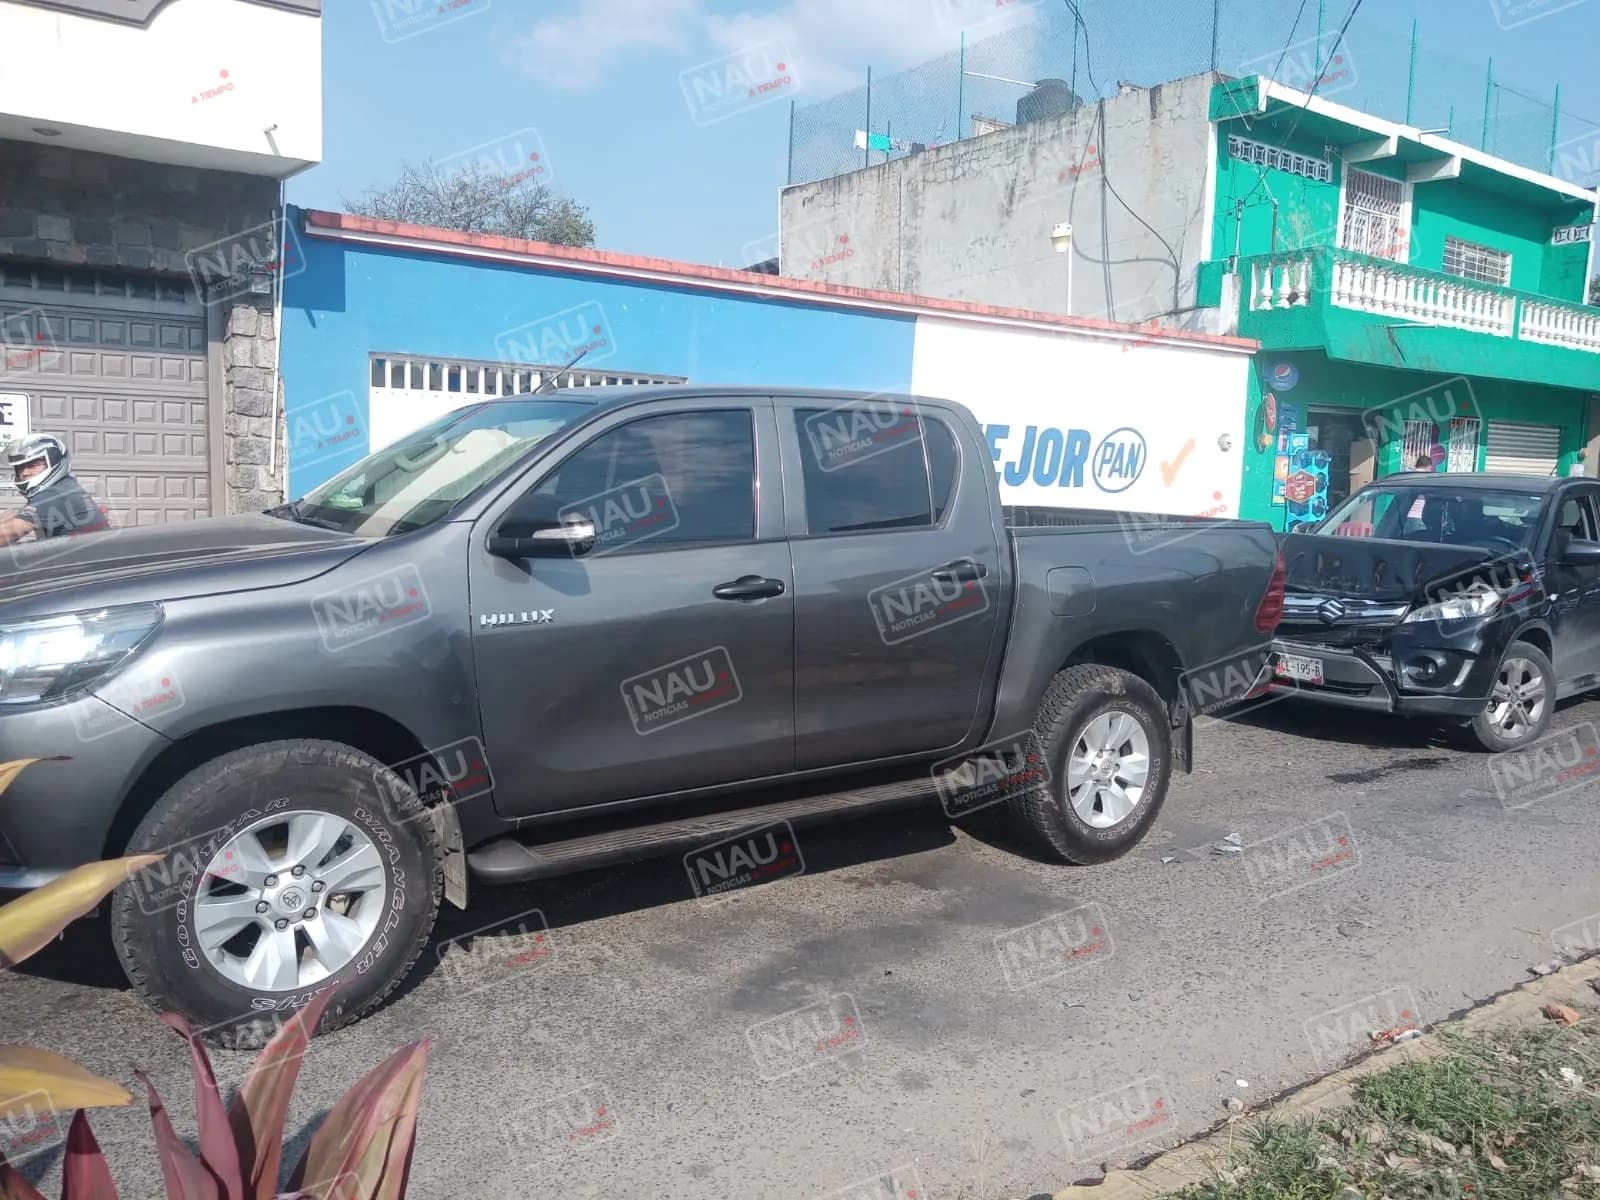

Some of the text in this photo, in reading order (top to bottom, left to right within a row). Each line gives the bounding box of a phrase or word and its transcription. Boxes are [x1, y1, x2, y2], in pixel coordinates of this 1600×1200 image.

[1097, 442, 1142, 478] PAN
[480, 608, 555, 628] HILUX
[354, 807, 406, 974] WRANGLER
